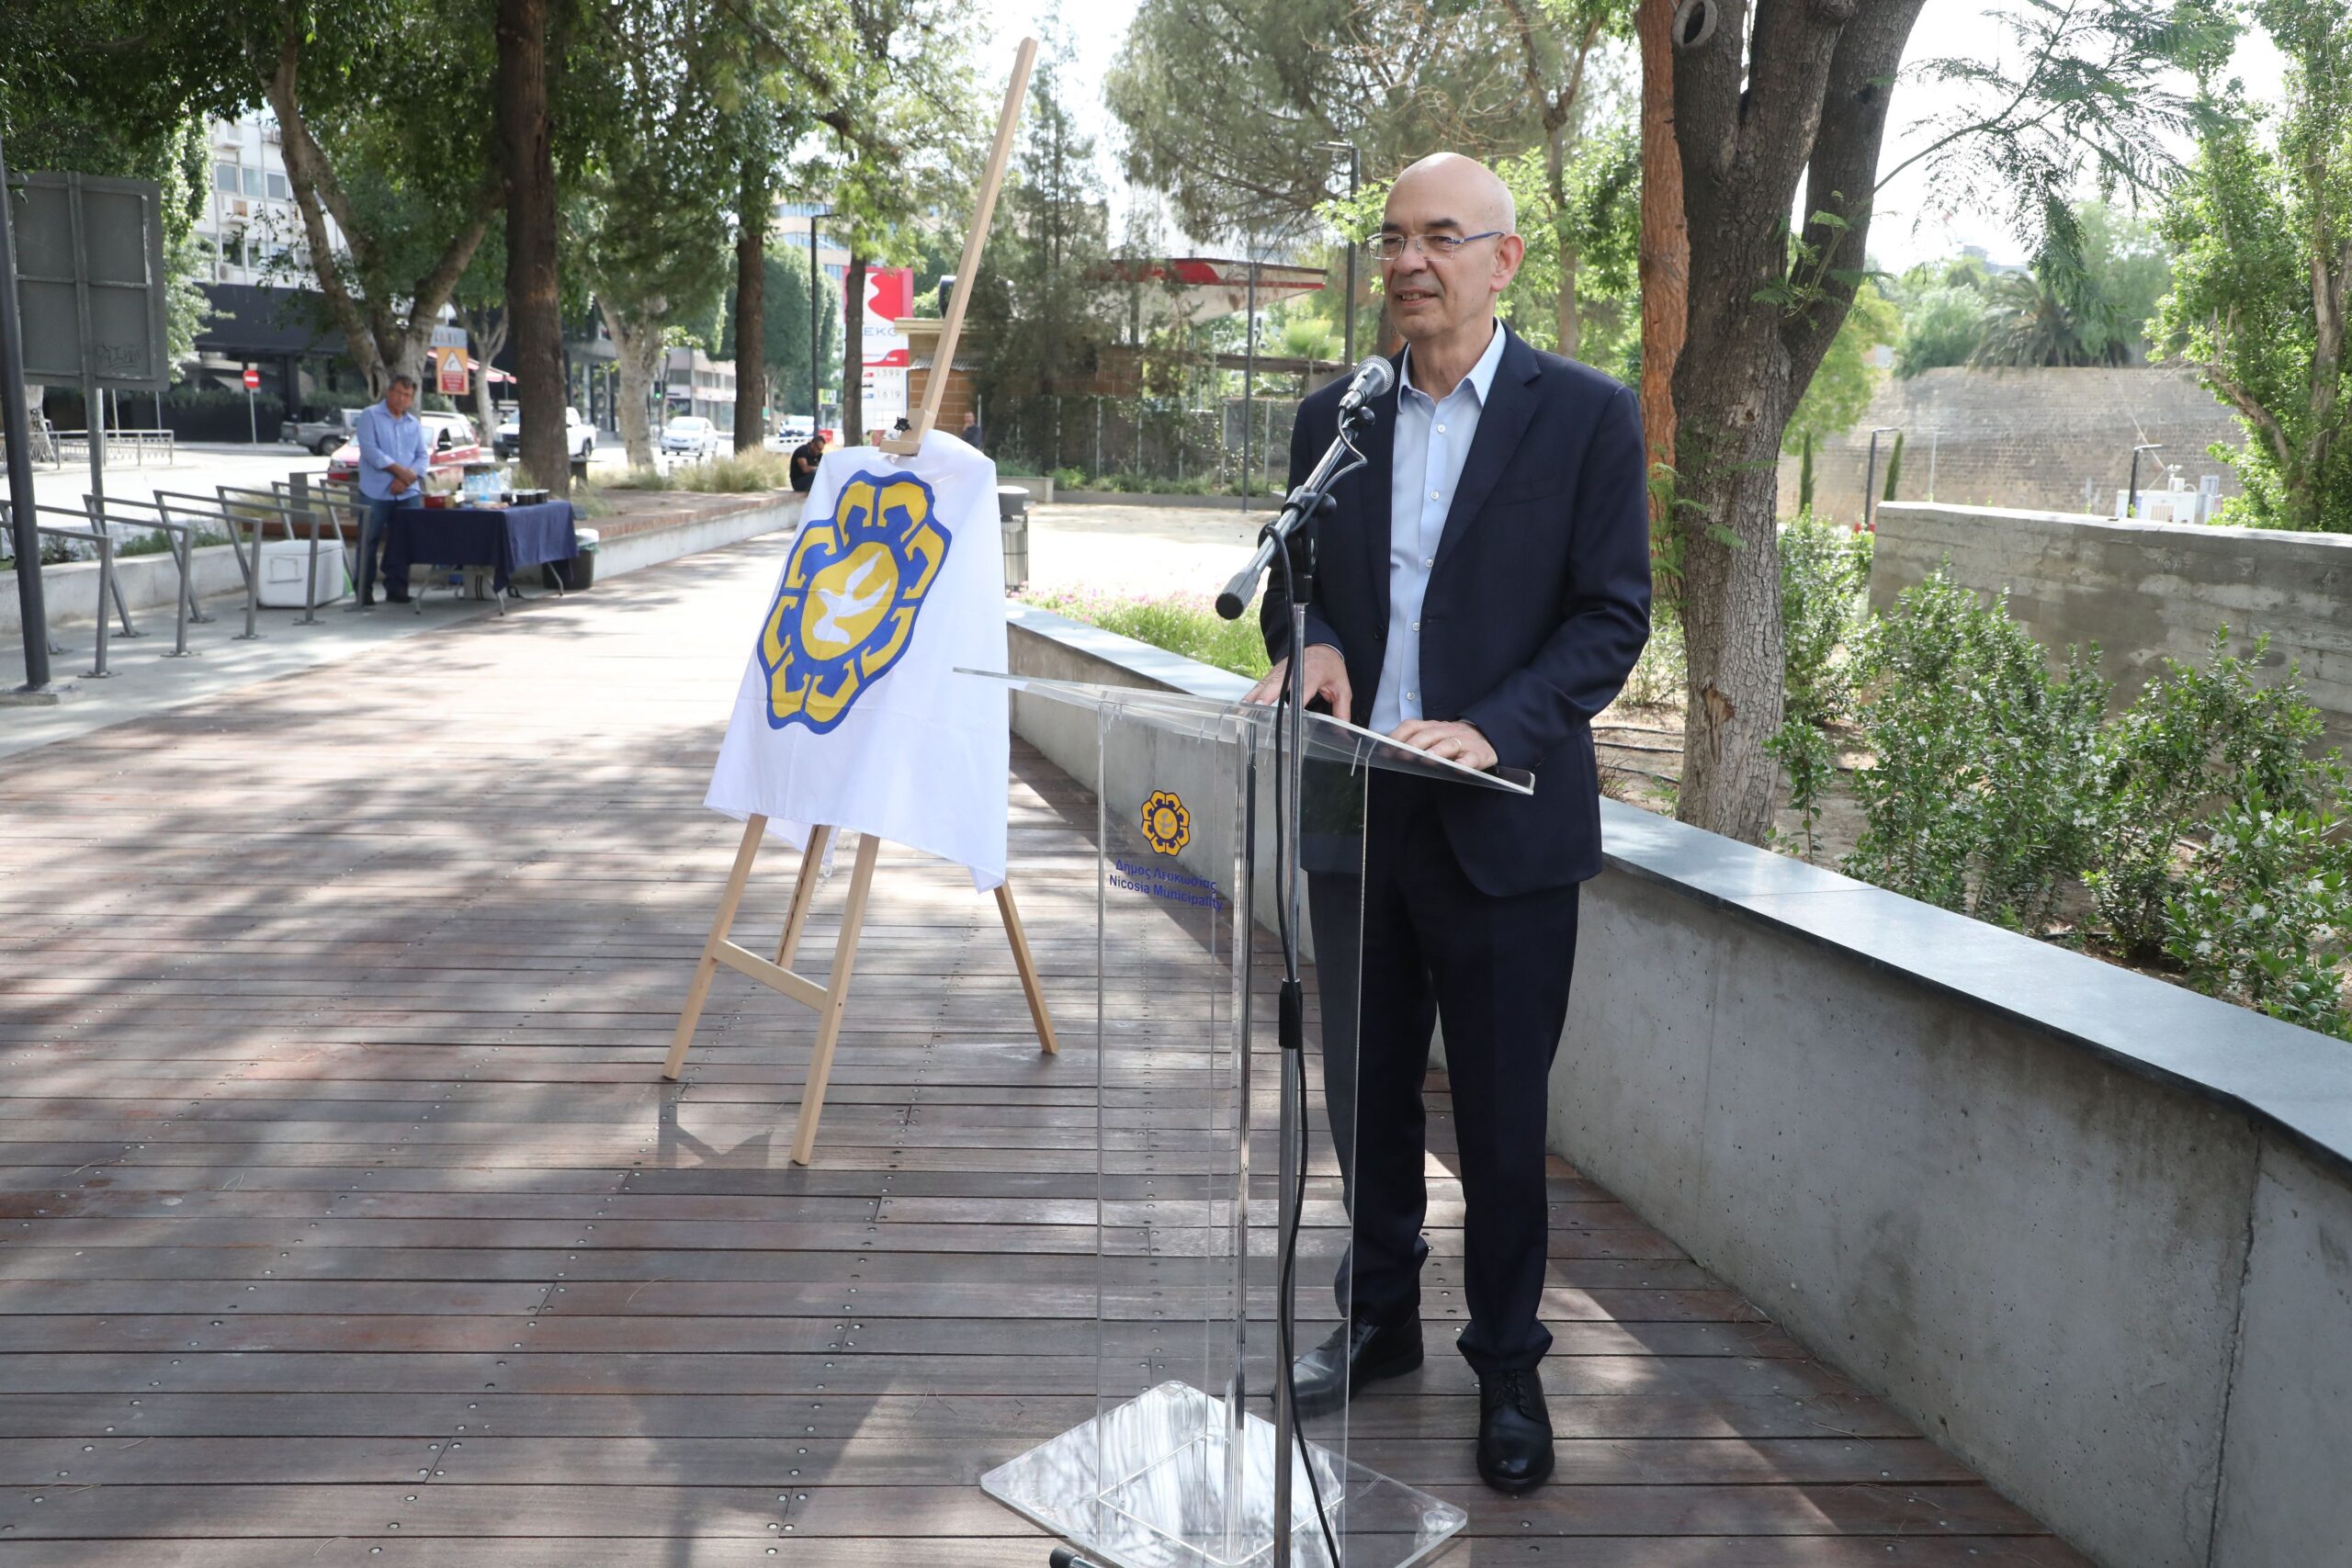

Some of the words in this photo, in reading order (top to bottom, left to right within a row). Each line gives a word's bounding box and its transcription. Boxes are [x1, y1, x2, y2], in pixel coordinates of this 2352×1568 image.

[1110, 874, 1150, 894] Nicosia
[1153, 884, 1223, 912] Municipality
[1116, 859, 1151, 880] Δήμος
[1154, 866, 1217, 893] Λευκωσίας
